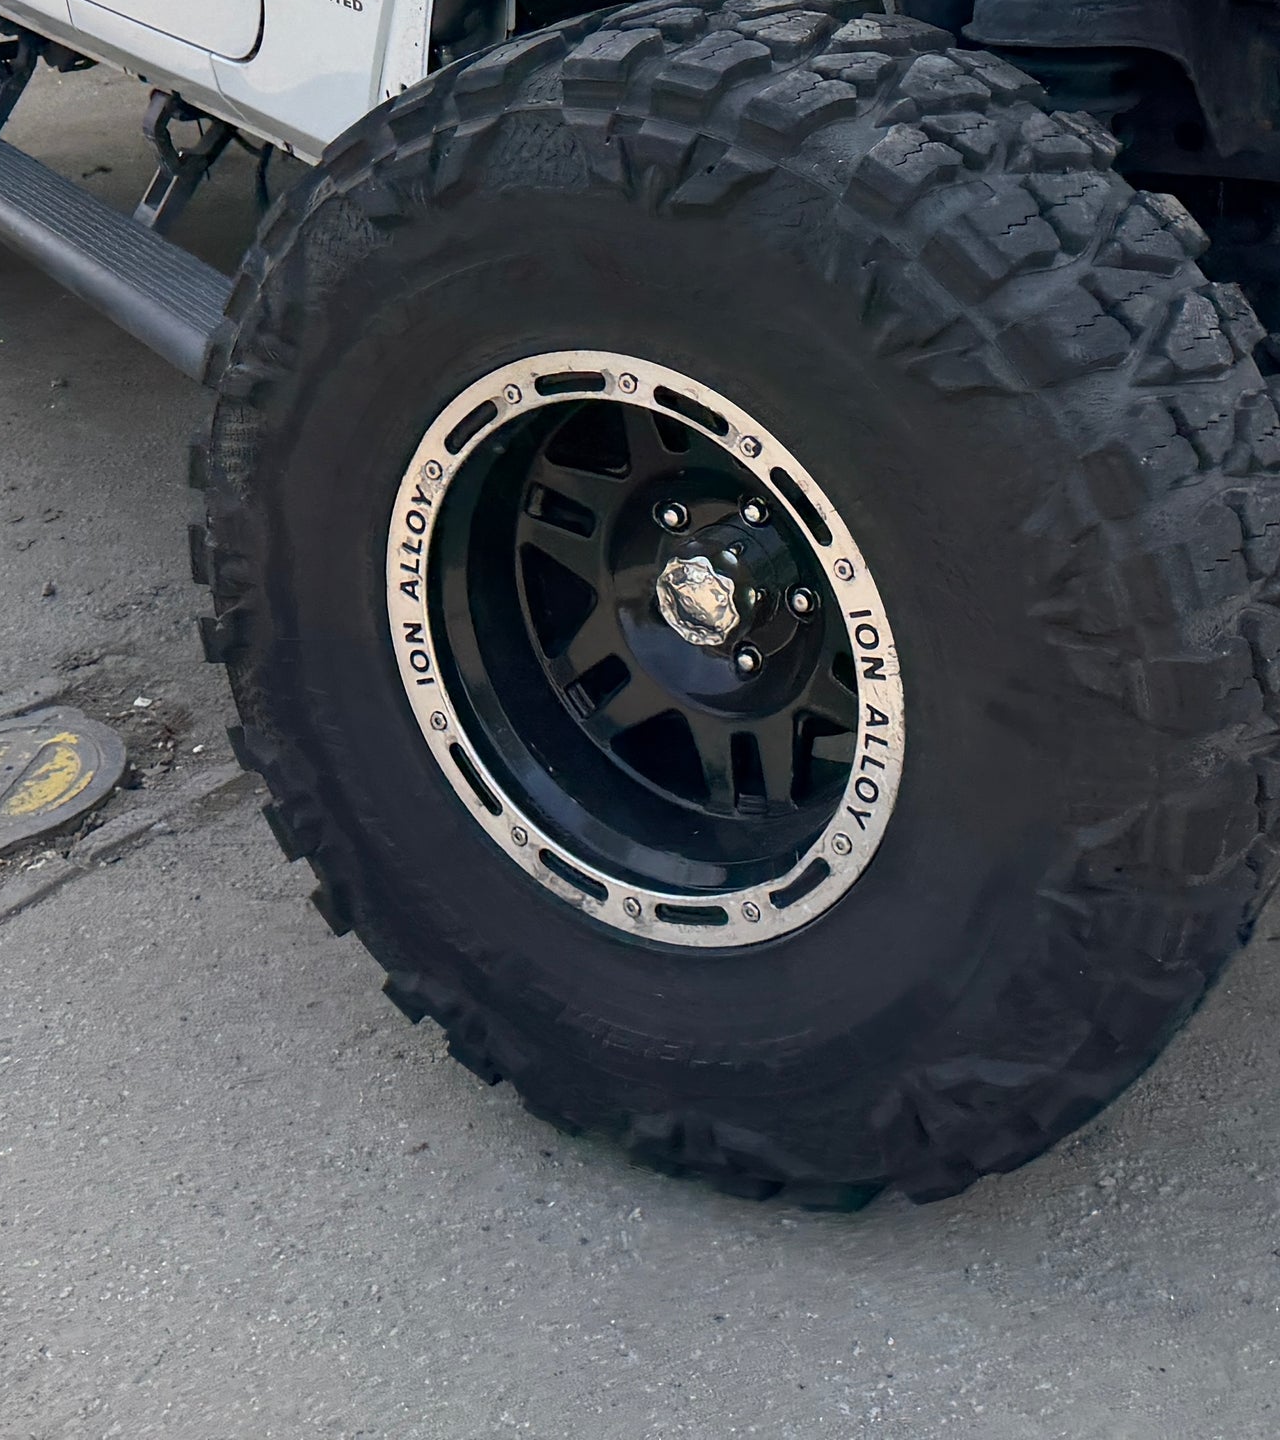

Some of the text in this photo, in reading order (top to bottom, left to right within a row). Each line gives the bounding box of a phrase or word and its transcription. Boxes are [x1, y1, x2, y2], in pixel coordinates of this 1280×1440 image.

[400, 483, 435, 686] ION ALLOY
[846, 609, 889, 831] ION ALLOY
